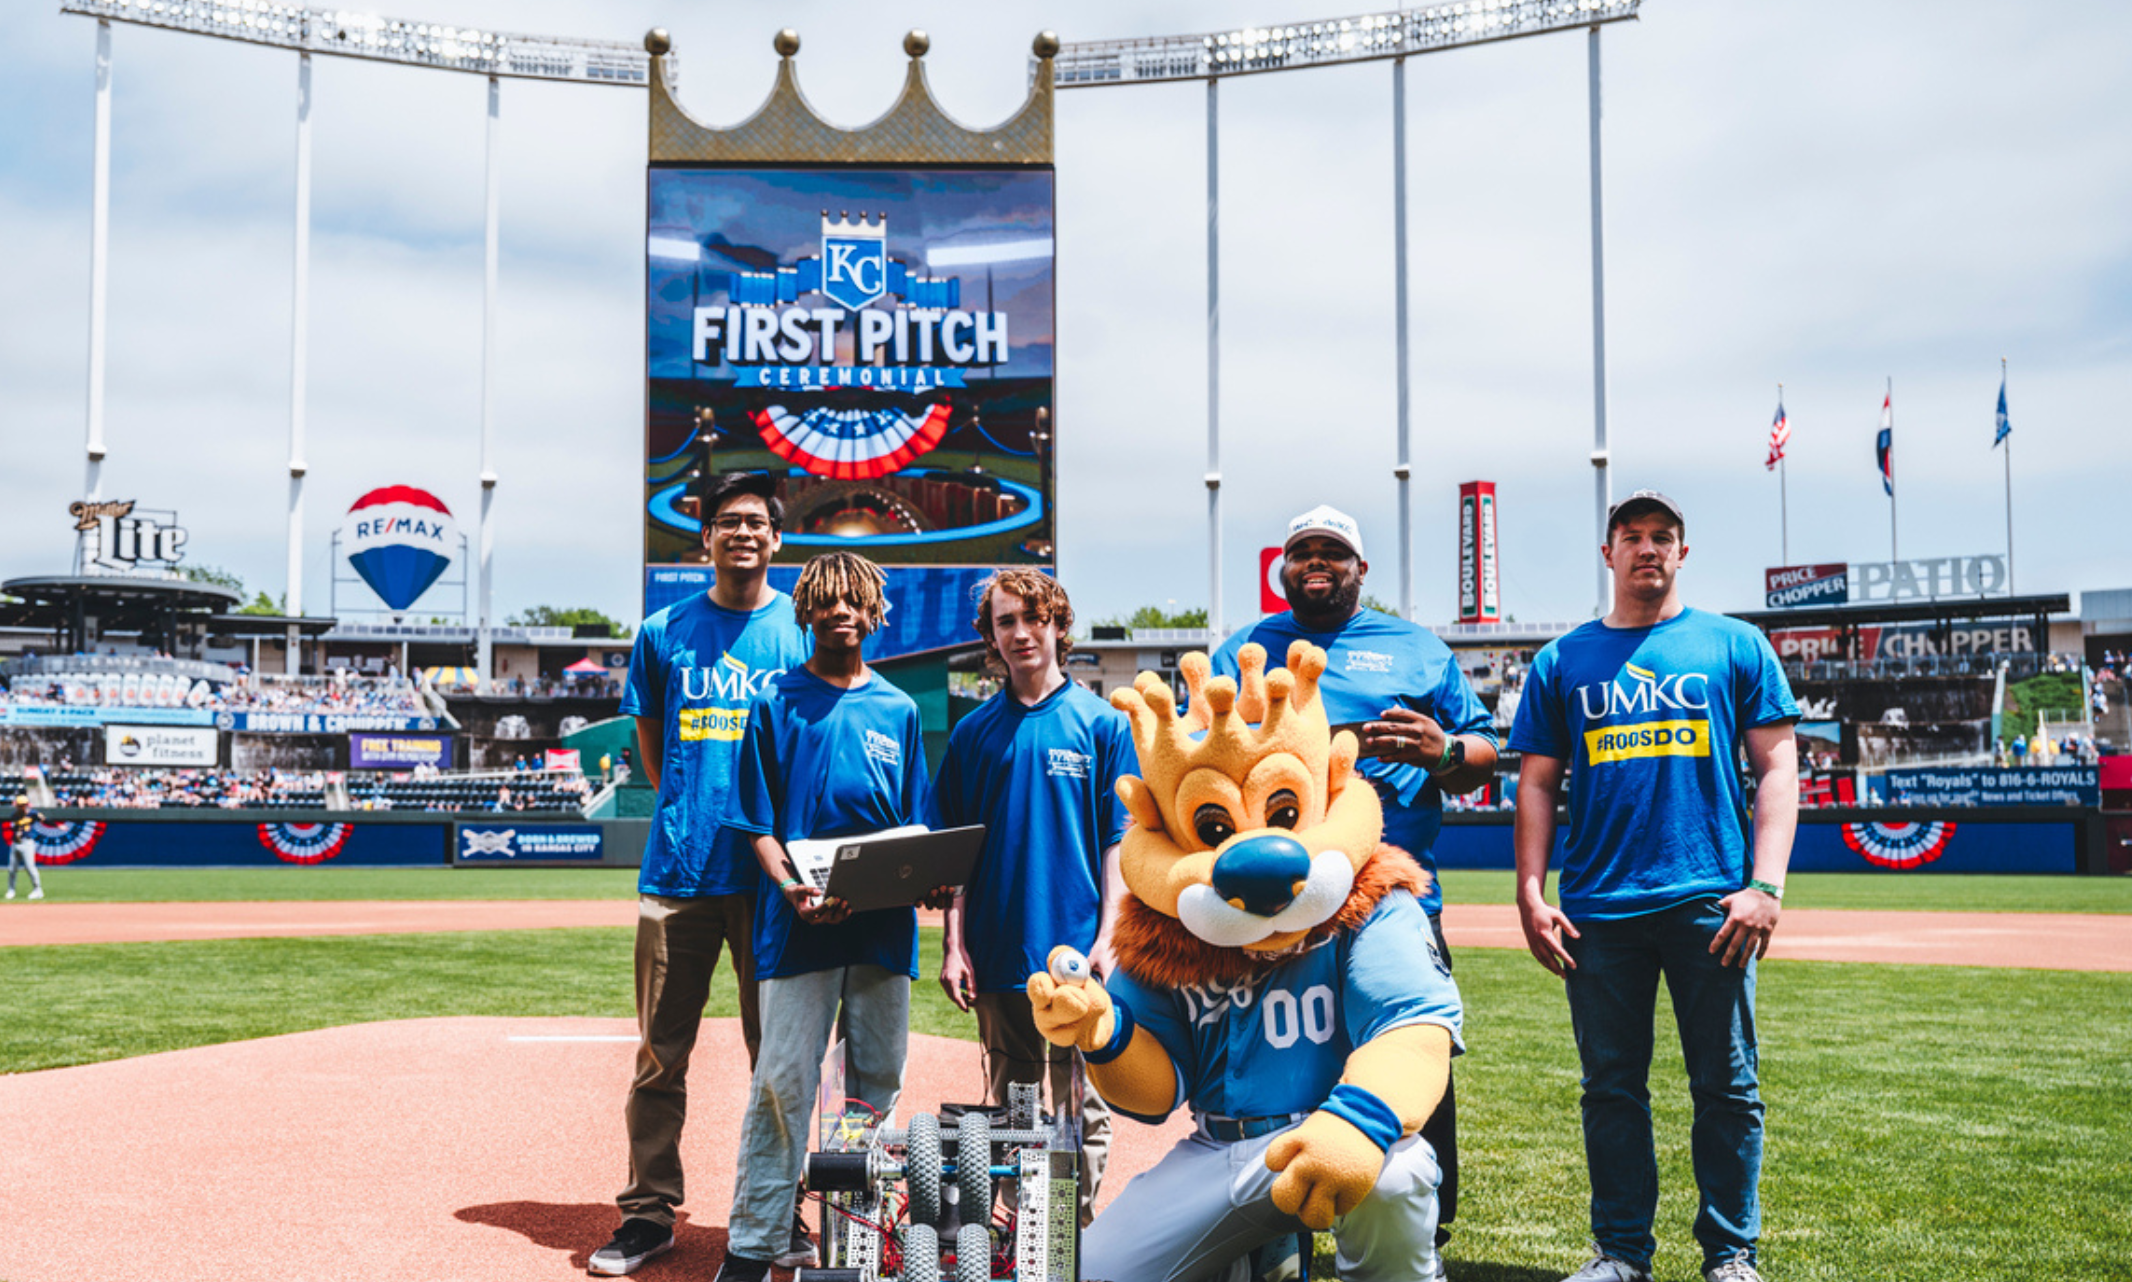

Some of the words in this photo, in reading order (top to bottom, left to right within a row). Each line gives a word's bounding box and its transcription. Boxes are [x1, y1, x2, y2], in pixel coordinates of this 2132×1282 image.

[827, 244, 882, 295] KC
[692, 307, 846, 363] FIRST
[859, 309, 1008, 363] PITCH
[758, 367, 945, 387] CEREMONIAL
[357, 516, 443, 542] RE/MAX
[93, 516, 188, 572] Lite
[1462, 504, 1475, 608] BOULEVARD
[1769, 567, 1817, 590] PRICE
[1858, 554, 2005, 600] PATIO
[1768, 576, 1846, 607] CHOPPER
[1577, 672, 1709, 720] UMKC
[246, 713, 304, 731] BROWN
[307, 713, 322, 732] &
[147, 734, 195, 747] planet
[152, 747, 204, 759] fitness
[1597, 727, 1697, 753] #ROOSDO
[1890, 774, 1917, 788] Text
[1921, 772, 1978, 790] "Royals"
[1982, 773, 1996, 787] to
[1263, 983, 1335, 1049] 00
